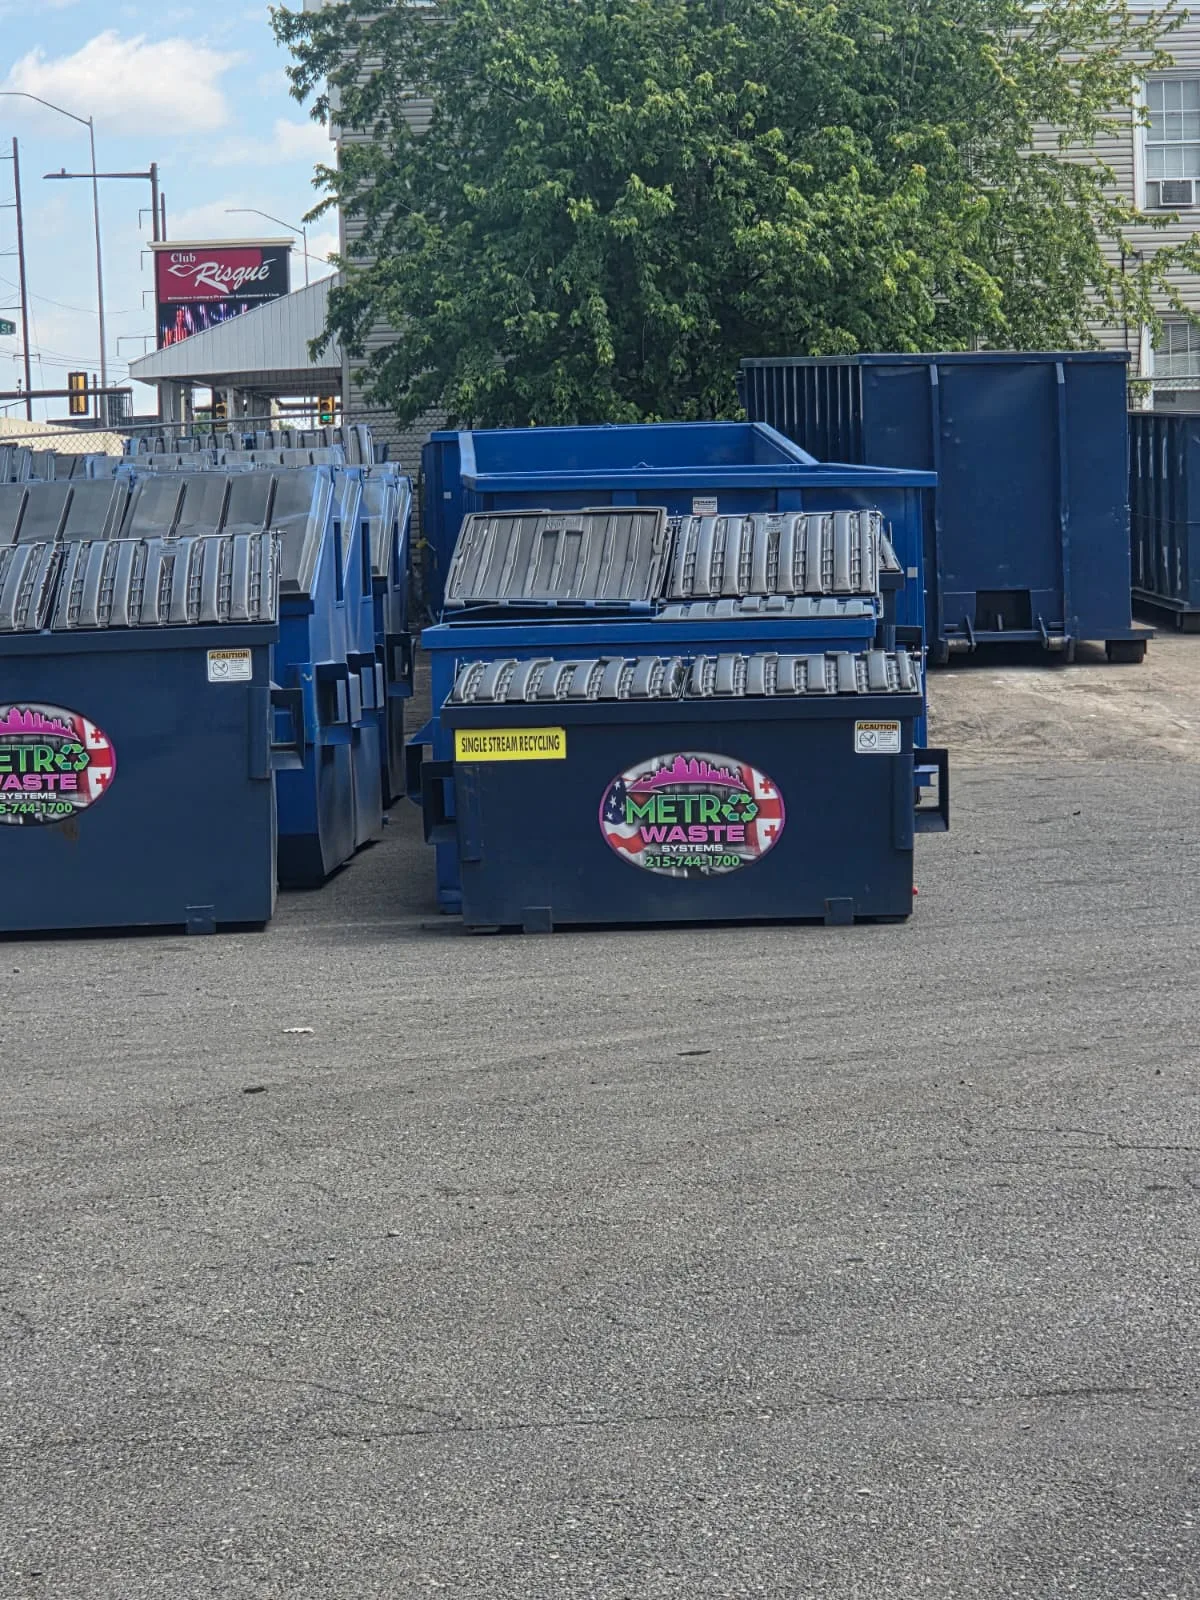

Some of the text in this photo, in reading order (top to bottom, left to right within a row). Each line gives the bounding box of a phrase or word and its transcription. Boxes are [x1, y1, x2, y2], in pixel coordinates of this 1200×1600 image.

[170, 252, 196, 263] Club
[193, 258, 277, 294] Risqué
[1, 323, 12, 334] St
[461, 735, 560, 752] SINGLE STREAM RECYCLING
[0, 773, 78, 791] ASTE
[0, 792, 57, 800] SYSTEMS
[0, 802, 73, 814] 5-744-1700
[640, 825, 745, 843] WASTE
[661, 844, 723, 853] SYSTEMS
[645, 855, 740, 867] 215-744-1700
